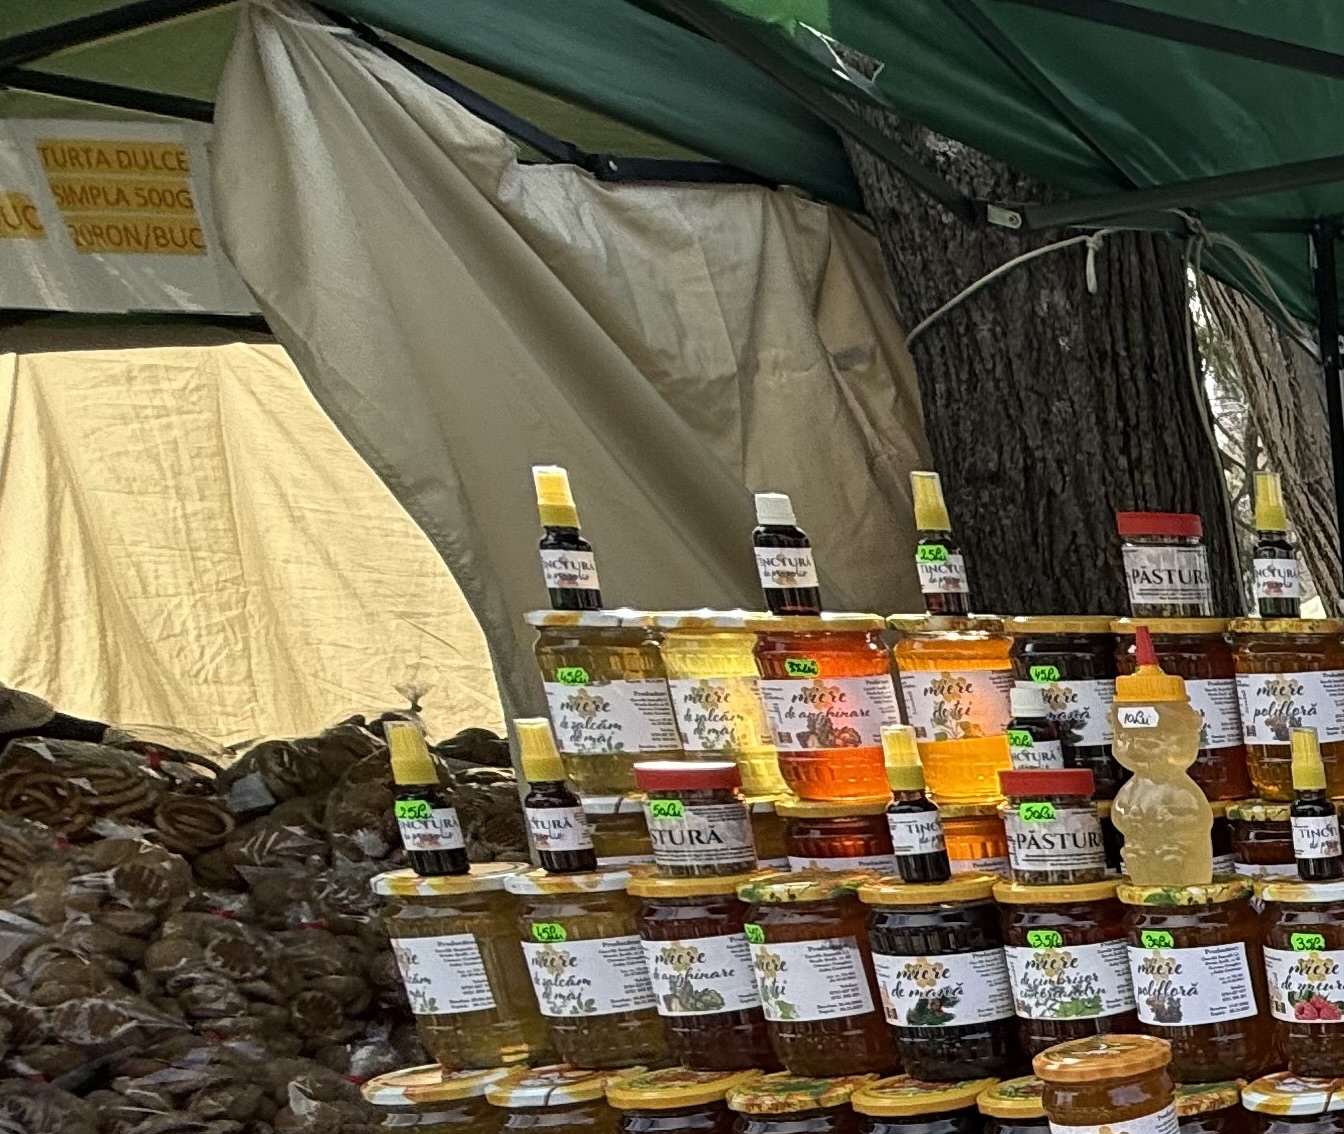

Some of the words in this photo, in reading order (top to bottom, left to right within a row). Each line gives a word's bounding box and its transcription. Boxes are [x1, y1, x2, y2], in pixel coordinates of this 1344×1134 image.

[38, 147, 109, 169] TURTA
[118, 150, 189, 171] DULCE
[52, 185, 129, 207] SIMPLA
[135, 188, 193, 208] 500G
